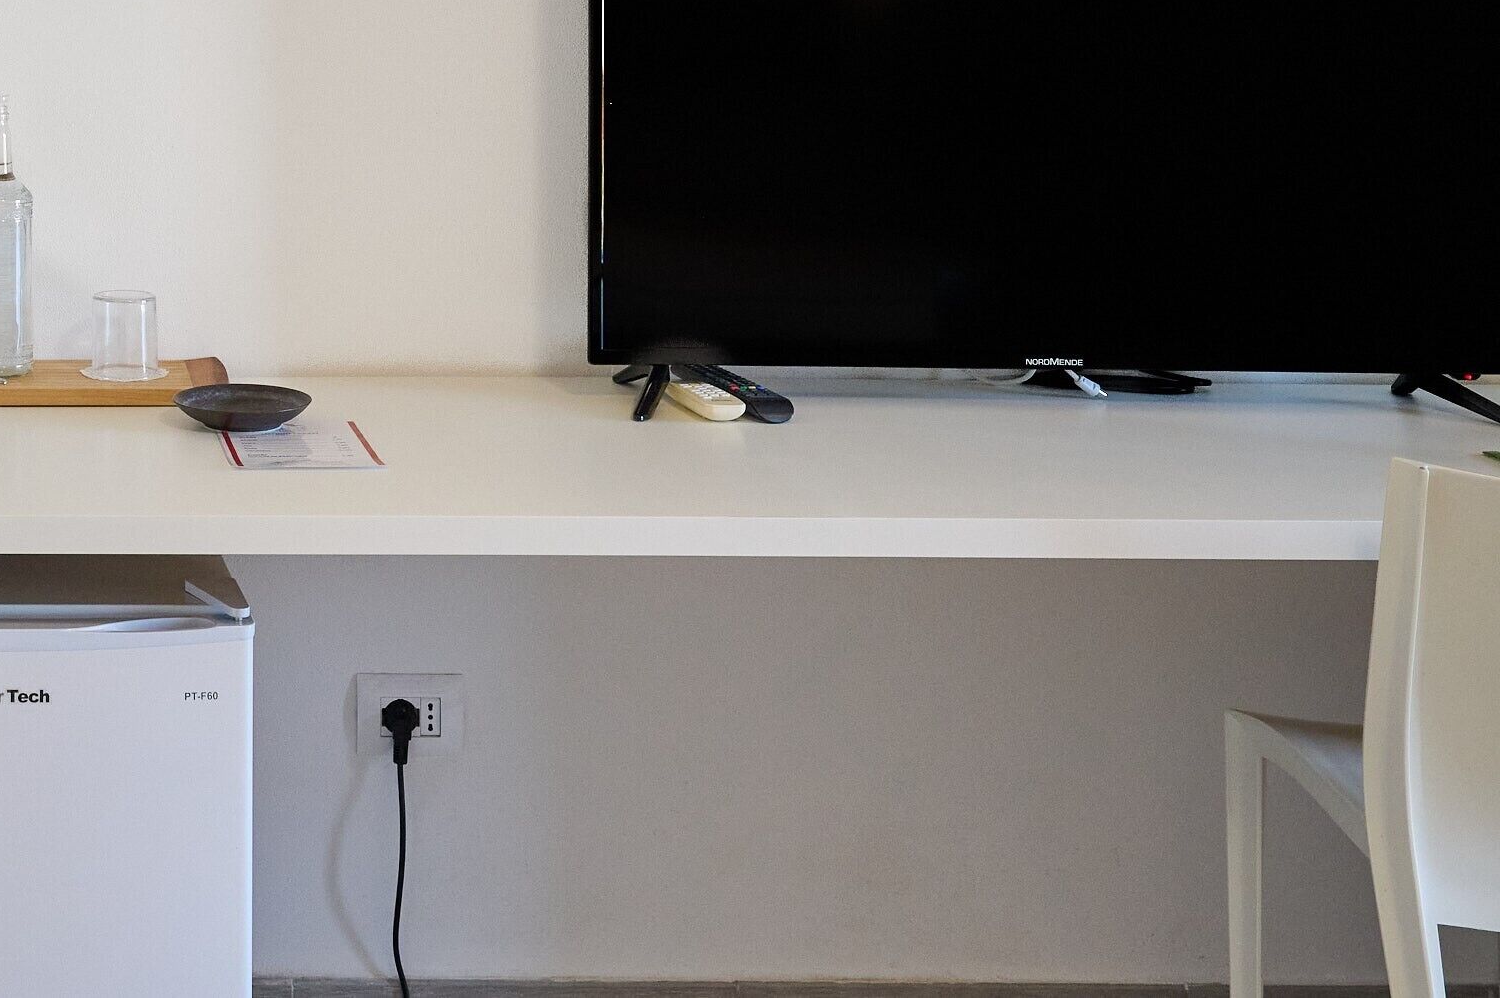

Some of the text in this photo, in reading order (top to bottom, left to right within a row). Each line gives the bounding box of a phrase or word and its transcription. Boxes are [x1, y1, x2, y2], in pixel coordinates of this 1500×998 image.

[1025, 357, 1084, 366] NORDMENDE
[7, 688, 50, 704] Tech
[184, 691, 219, 701] PT-F60
